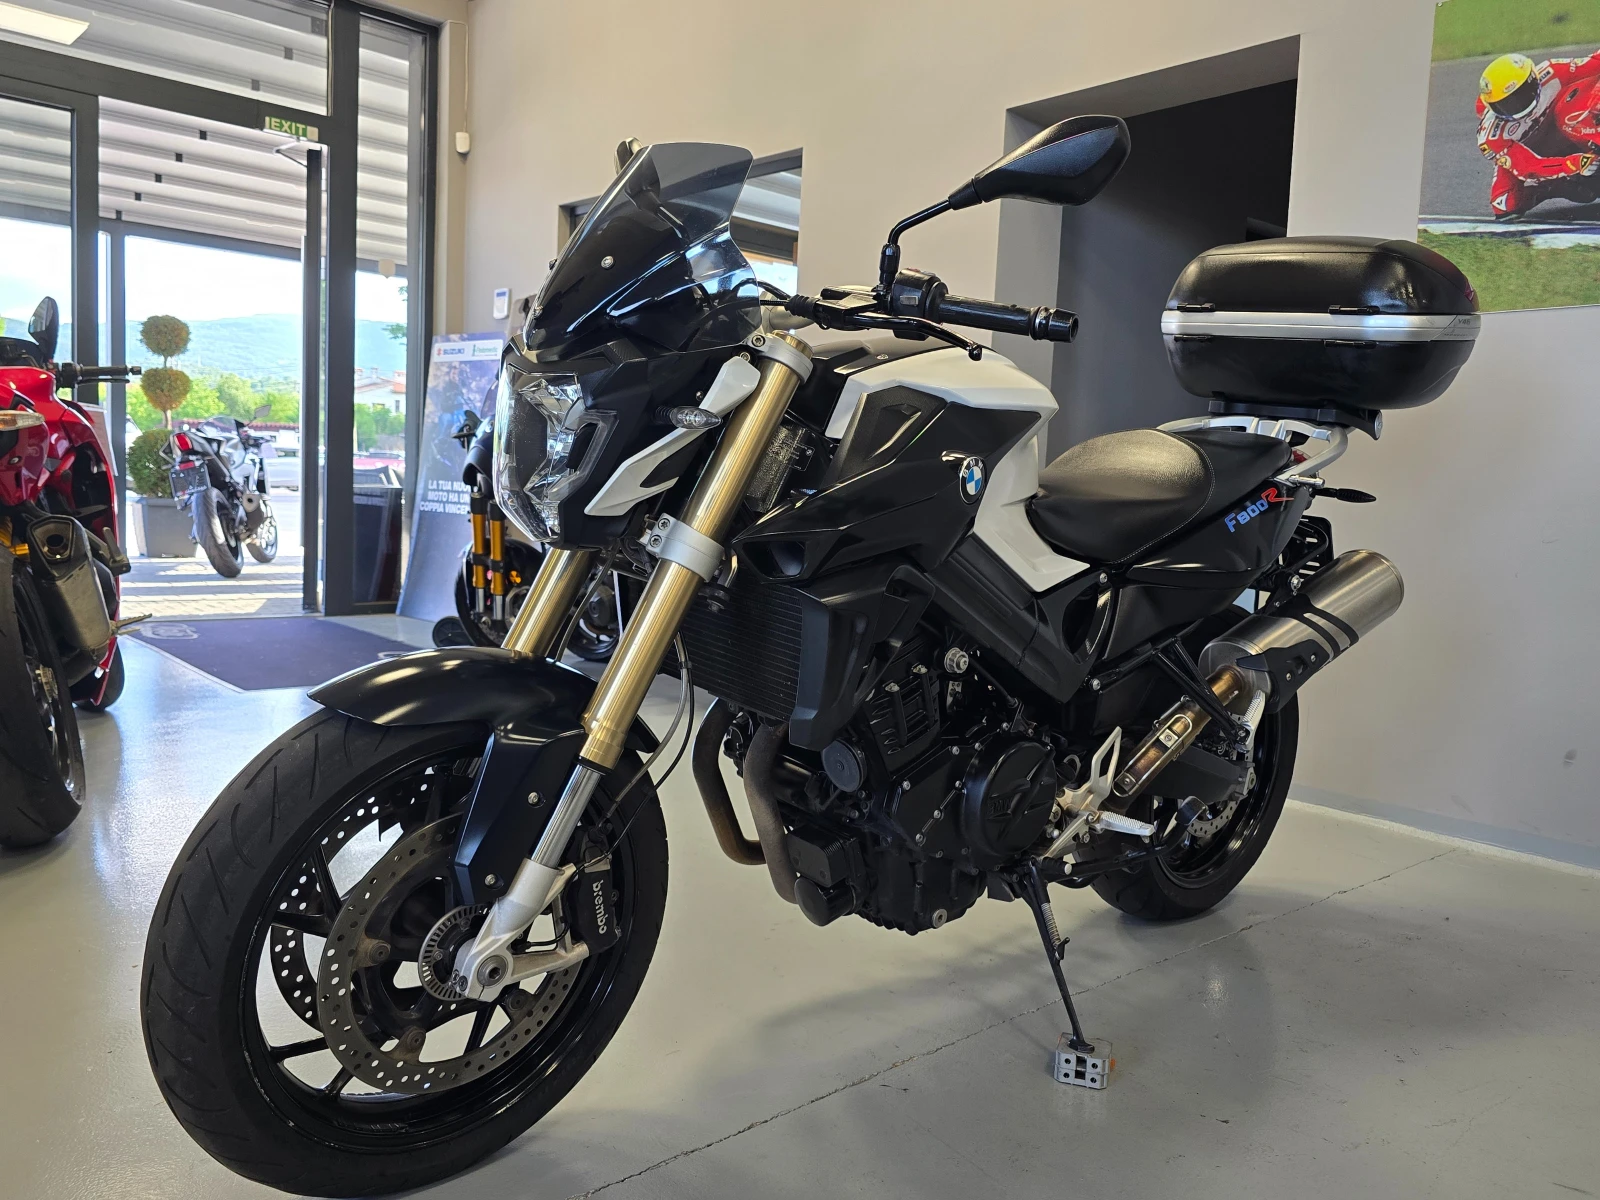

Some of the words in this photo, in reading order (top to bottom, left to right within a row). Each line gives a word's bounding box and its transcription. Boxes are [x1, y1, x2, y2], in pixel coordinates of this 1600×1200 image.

[270, 117, 306, 136] EXIT
[962, 458, 984, 478] BMW
[428, 480, 437, 490] LA
[438, 480, 452, 491] TUA
[428, 491, 448, 502] MOTO
[449, 492, 459, 503] HA
[420, 501, 444, 513] COPPIA
[592, 879, 609, 935] brembo
